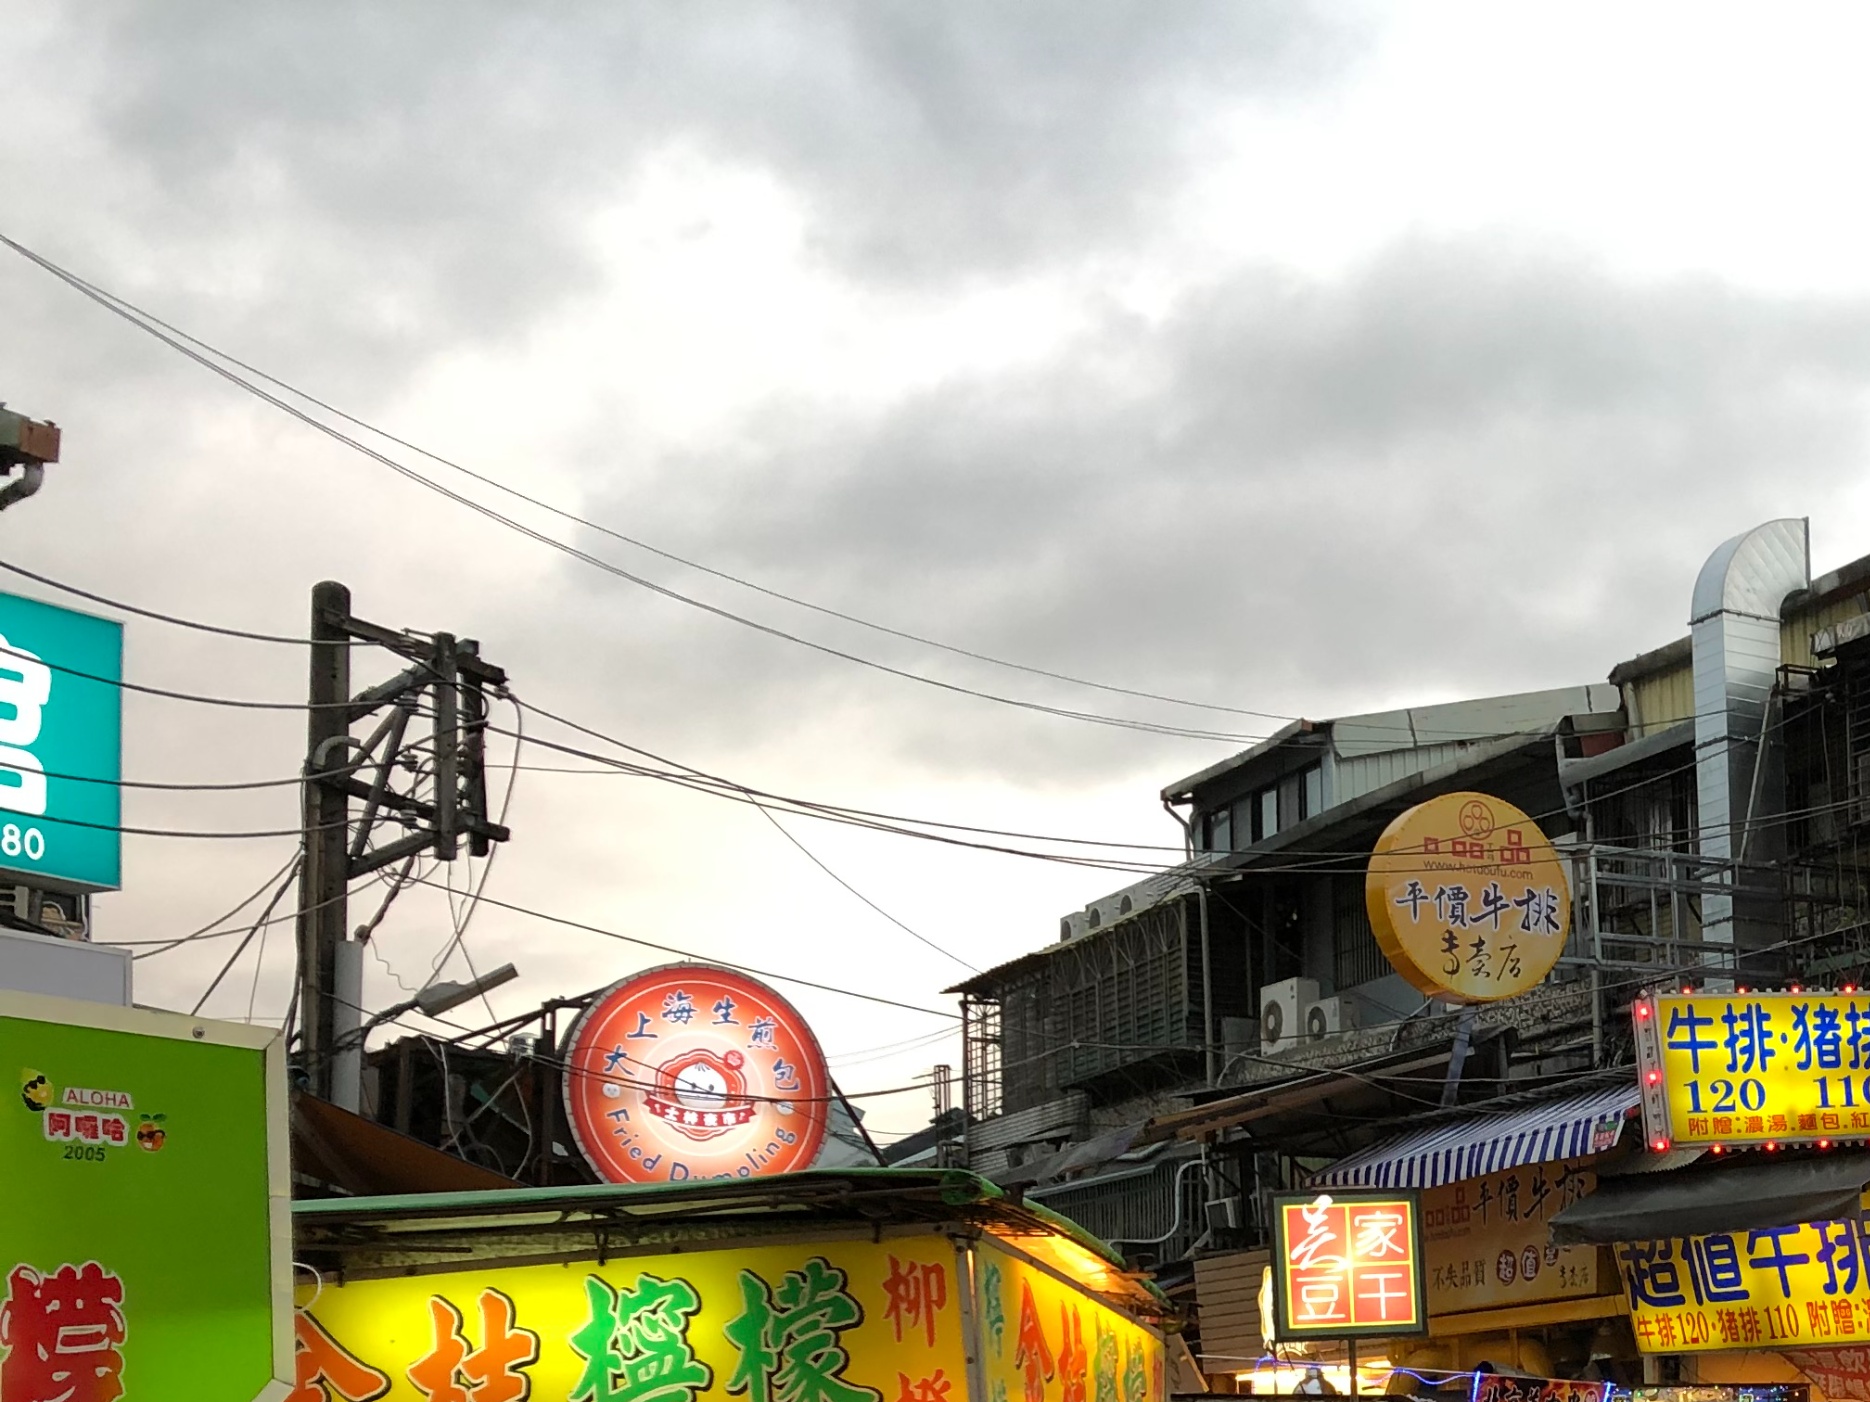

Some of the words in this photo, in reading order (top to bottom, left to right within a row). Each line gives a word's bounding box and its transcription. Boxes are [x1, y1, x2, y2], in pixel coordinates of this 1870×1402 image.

[1396, 881, 1560, 934] 平價牛排
[604, 991, 799, 1091] 大上海生煎包
[65, 1087, 131, 1110] ALOHA
[1683, 1077, 1766, 1114] 120
[63, 1145, 106, 1163] 2005
[607, 1108, 662, 1171] Fried
[1297, 1273, 1408, 1320] 豆干
